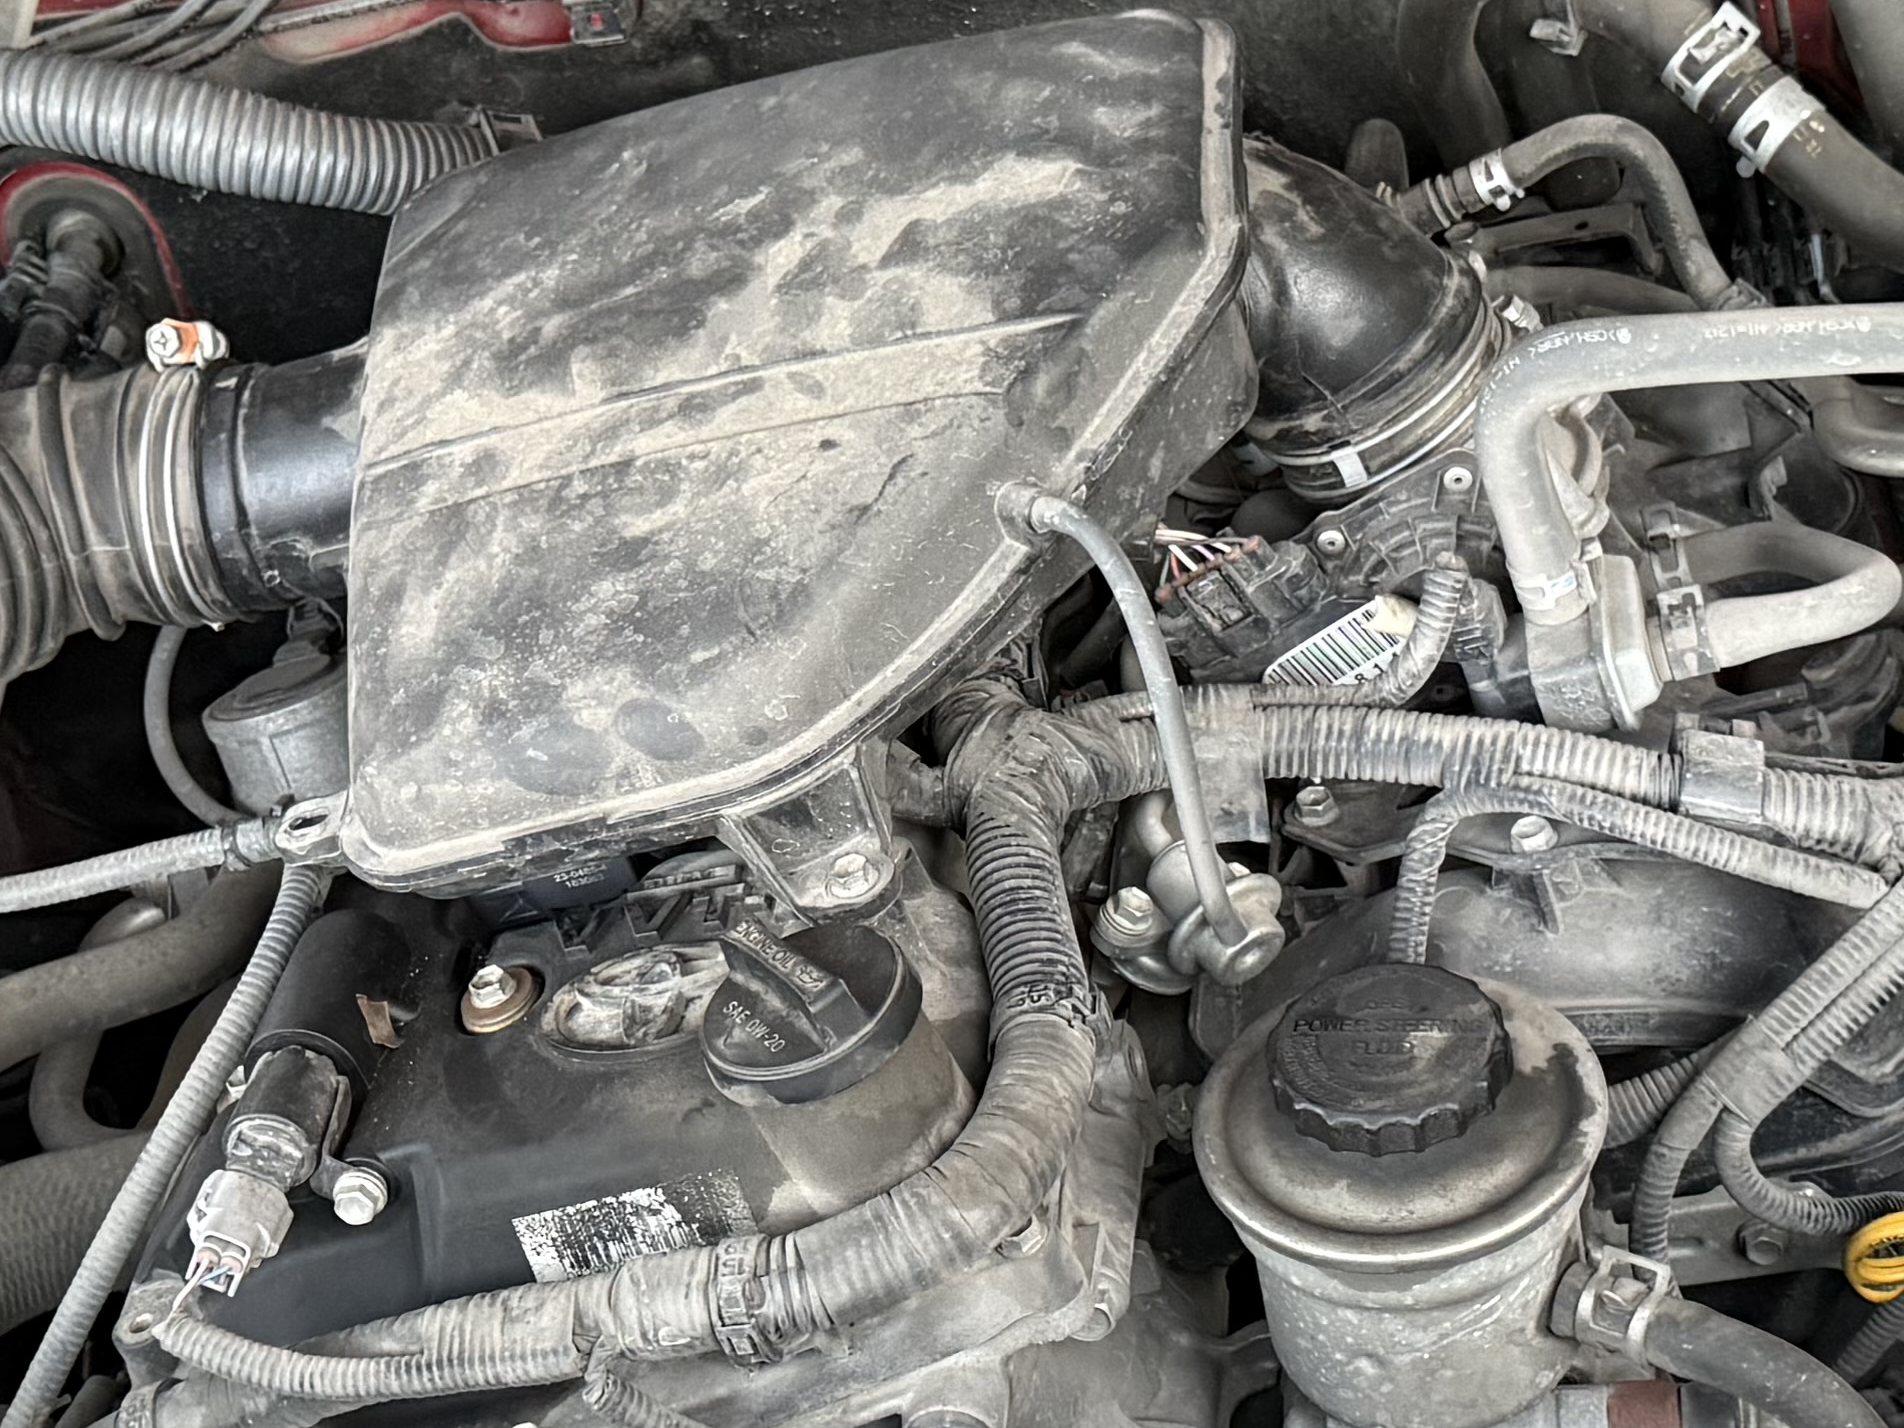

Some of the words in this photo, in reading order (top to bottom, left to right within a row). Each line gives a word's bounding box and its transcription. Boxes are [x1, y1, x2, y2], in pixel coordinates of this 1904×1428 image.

[723, 1001, 751, 1024] SAE
[745, 1019, 786, 1052] 0W-20
[1293, 1018, 1369, 1033] POWER
